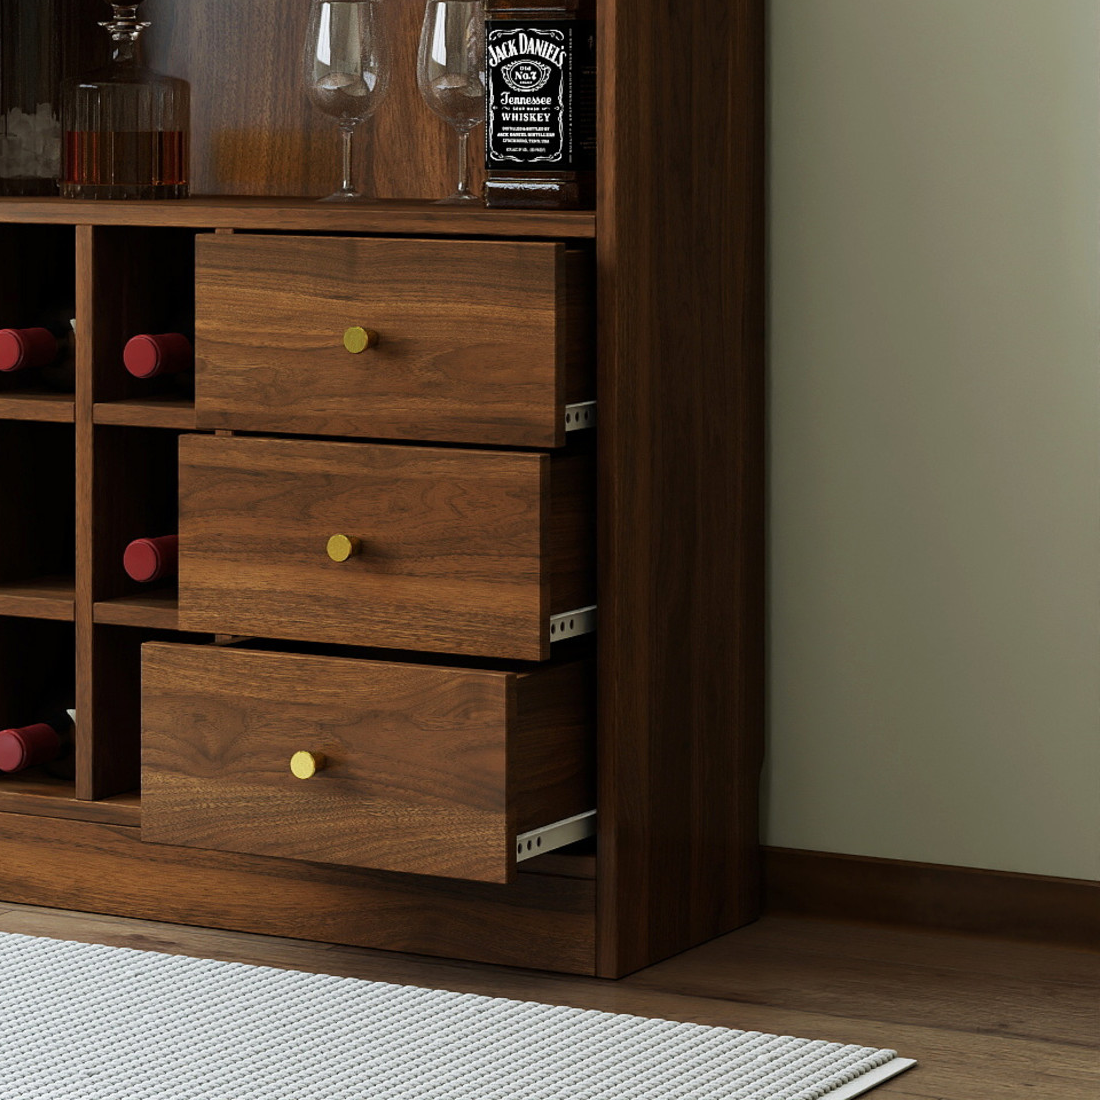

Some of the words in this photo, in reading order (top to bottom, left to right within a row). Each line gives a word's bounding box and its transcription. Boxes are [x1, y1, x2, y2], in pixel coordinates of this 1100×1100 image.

[488, 38, 518, 68] JACK
[500, 91, 552, 105] Tennessee
[501, 112, 551, 122] WHISKEY
